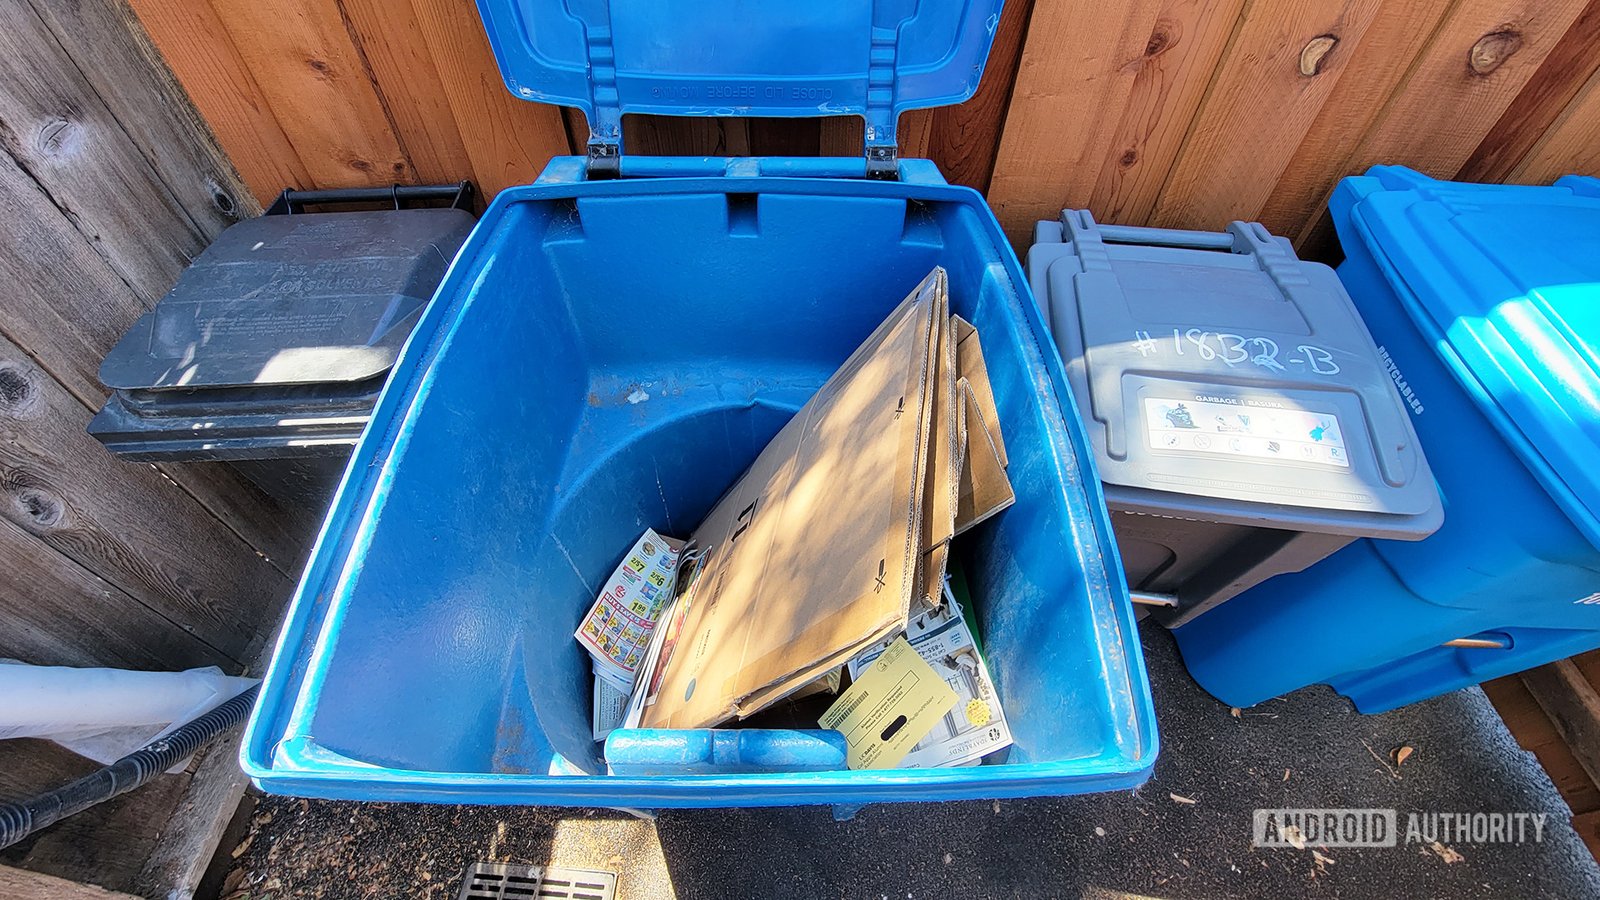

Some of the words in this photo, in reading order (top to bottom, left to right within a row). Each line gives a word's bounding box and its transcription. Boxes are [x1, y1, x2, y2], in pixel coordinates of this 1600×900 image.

[707, 85, 756, 98] BEFORE
[765, 86, 784, 98] LID
[792, 86, 833, 99] CLOSE
[1377, 345, 1425, 415] RECYCLABLES
[1195, 395, 1238, 405] GARBAGE
[1247, 400, 1285, 409] BASURA
